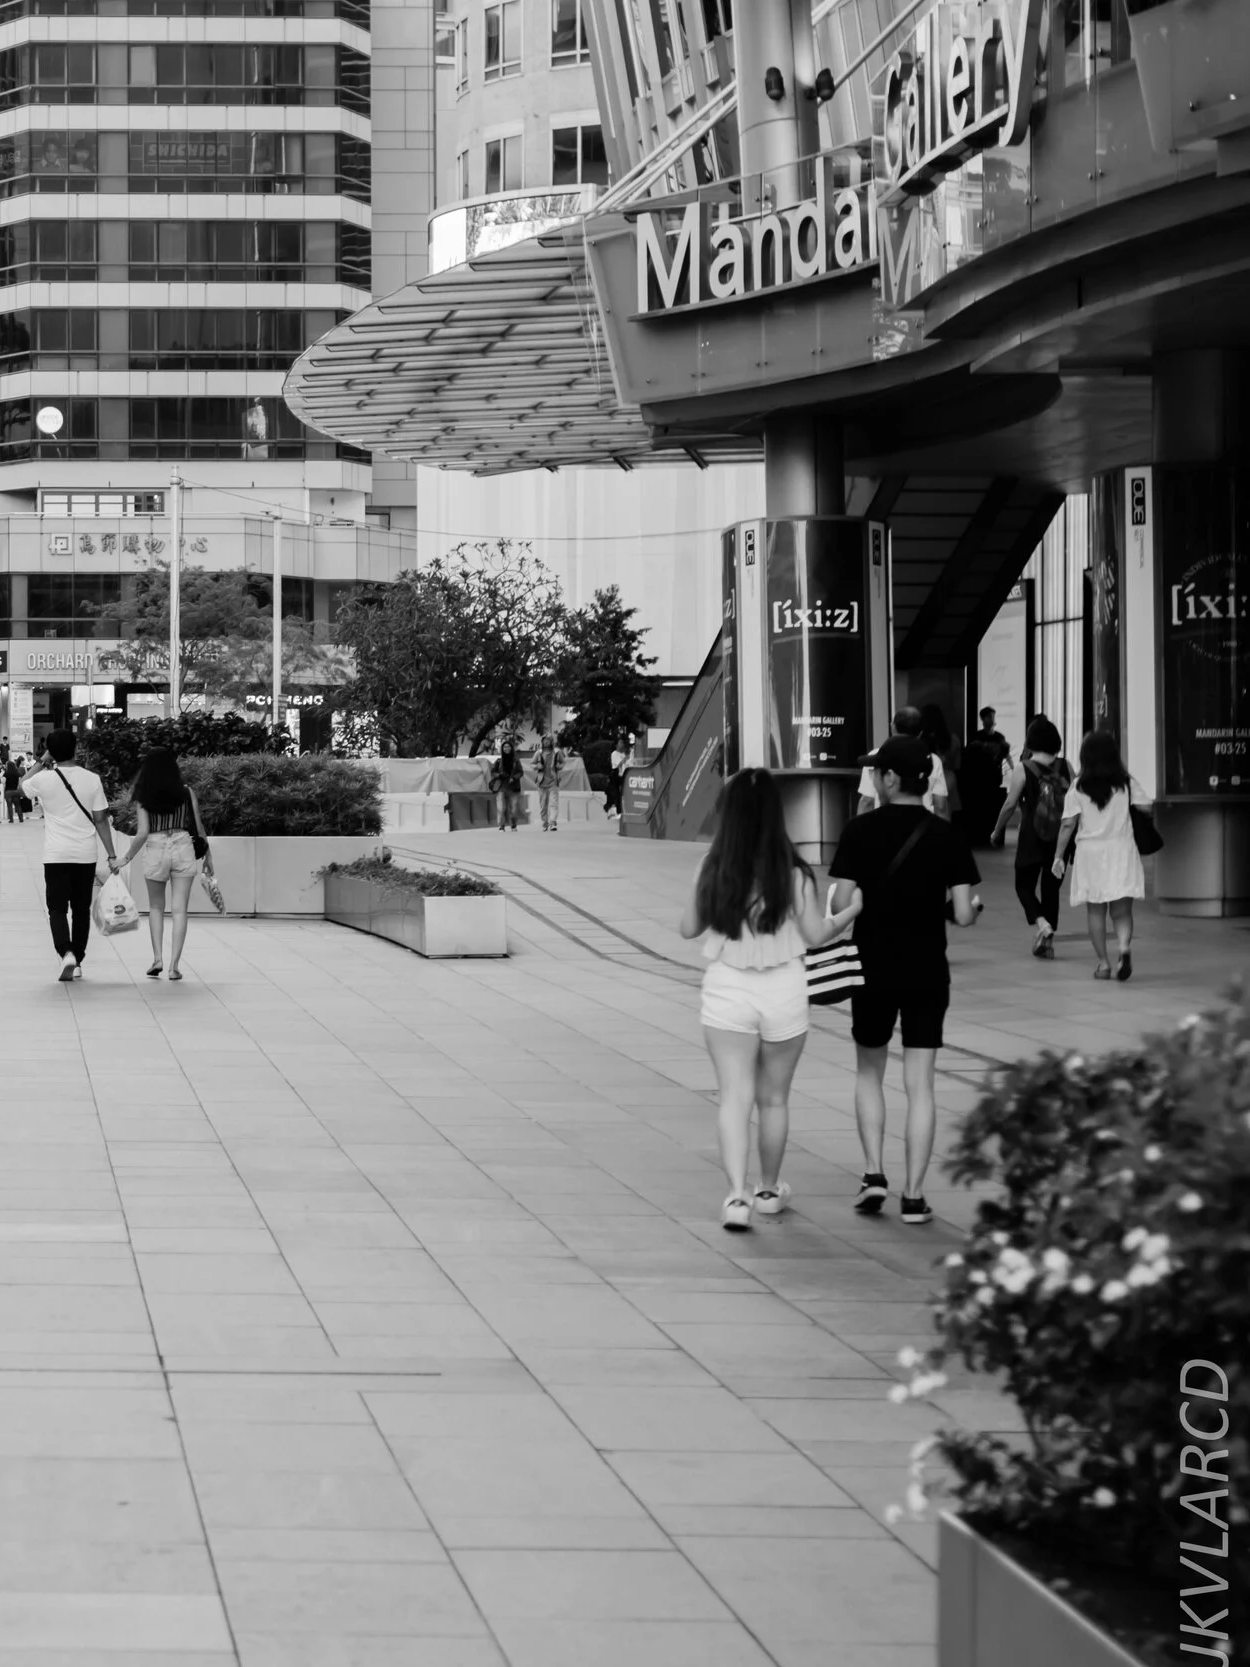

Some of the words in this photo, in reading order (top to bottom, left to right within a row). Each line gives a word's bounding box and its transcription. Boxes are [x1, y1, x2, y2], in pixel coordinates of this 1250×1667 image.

[884, 0, 1030, 184] Gallery
[148, 143, 228, 156] SHICHIDA
[745, 530, 755, 565] OUE
[27, 653, 93, 669] ORCHARD
[822, 716, 845, 725] GALLERY
[1195, 727, 1234, 738] MANDARIN
